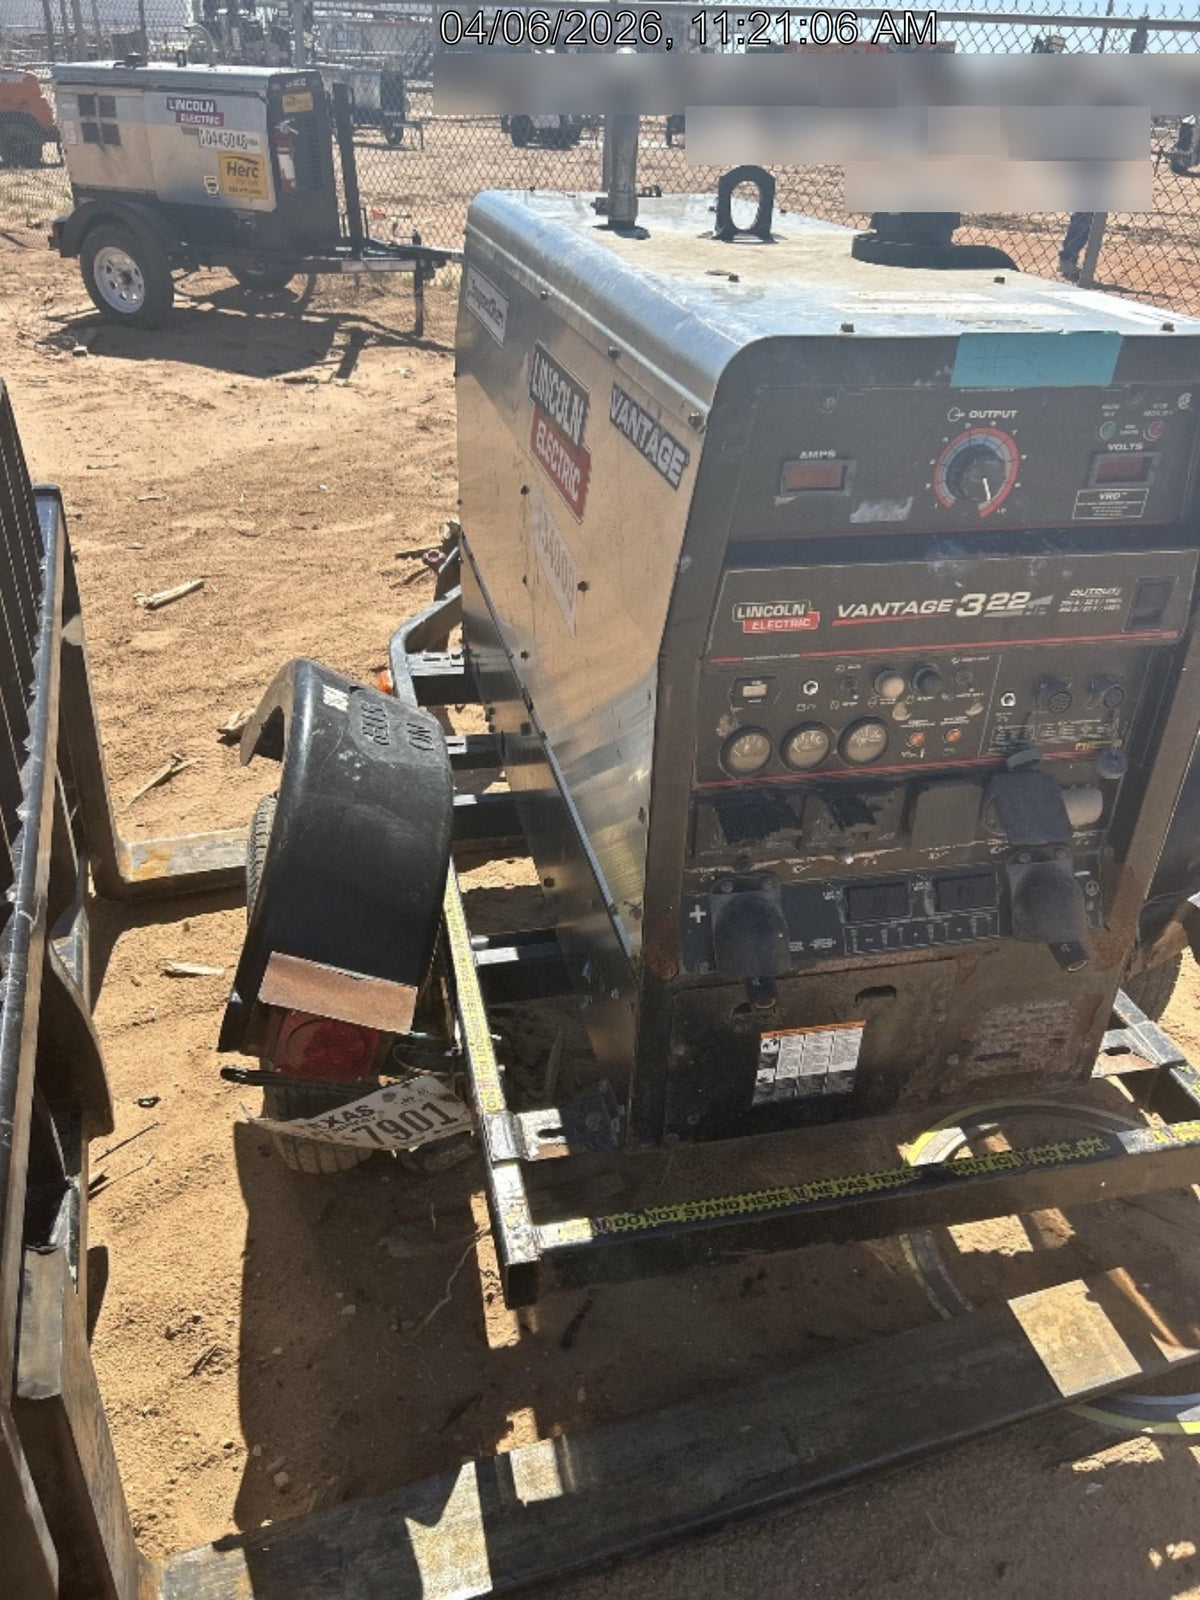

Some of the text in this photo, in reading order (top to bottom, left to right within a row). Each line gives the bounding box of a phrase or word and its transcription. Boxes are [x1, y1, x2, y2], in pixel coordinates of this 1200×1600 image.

[169, 98, 215, 113] LINCOLN
[179, 114, 220, 125] ELECTRIC
[227, 161, 260, 178] Herc
[532, 352, 585, 446] LINCOLN
[968, 409, 1018, 418] OUTPUT
[610, 386, 689, 488] VANTAGE
[1107, 442, 1144, 451] VOLTS
[535, 418, 581, 502] ELECTRIC
[799, 449, 836, 460] AMPS
[737, 604, 806, 619] LINCOLN
[838, 599, 954, 618] VANTAGE
[956, 591, 1032, 617] 322
[752, 618, 811, 630] ELECTRIC
[614, 1215, 641, 1228] DO
[645, 1208, 680, 1222] NOT
[683, 1200, 741, 1217] STAND
[745, 1193, 789, 1207] HERE
[810, 1184, 834, 1195] NE
[836, 1178, 869, 1191] PAS
[992, 1156, 1013, 1168] ICI
